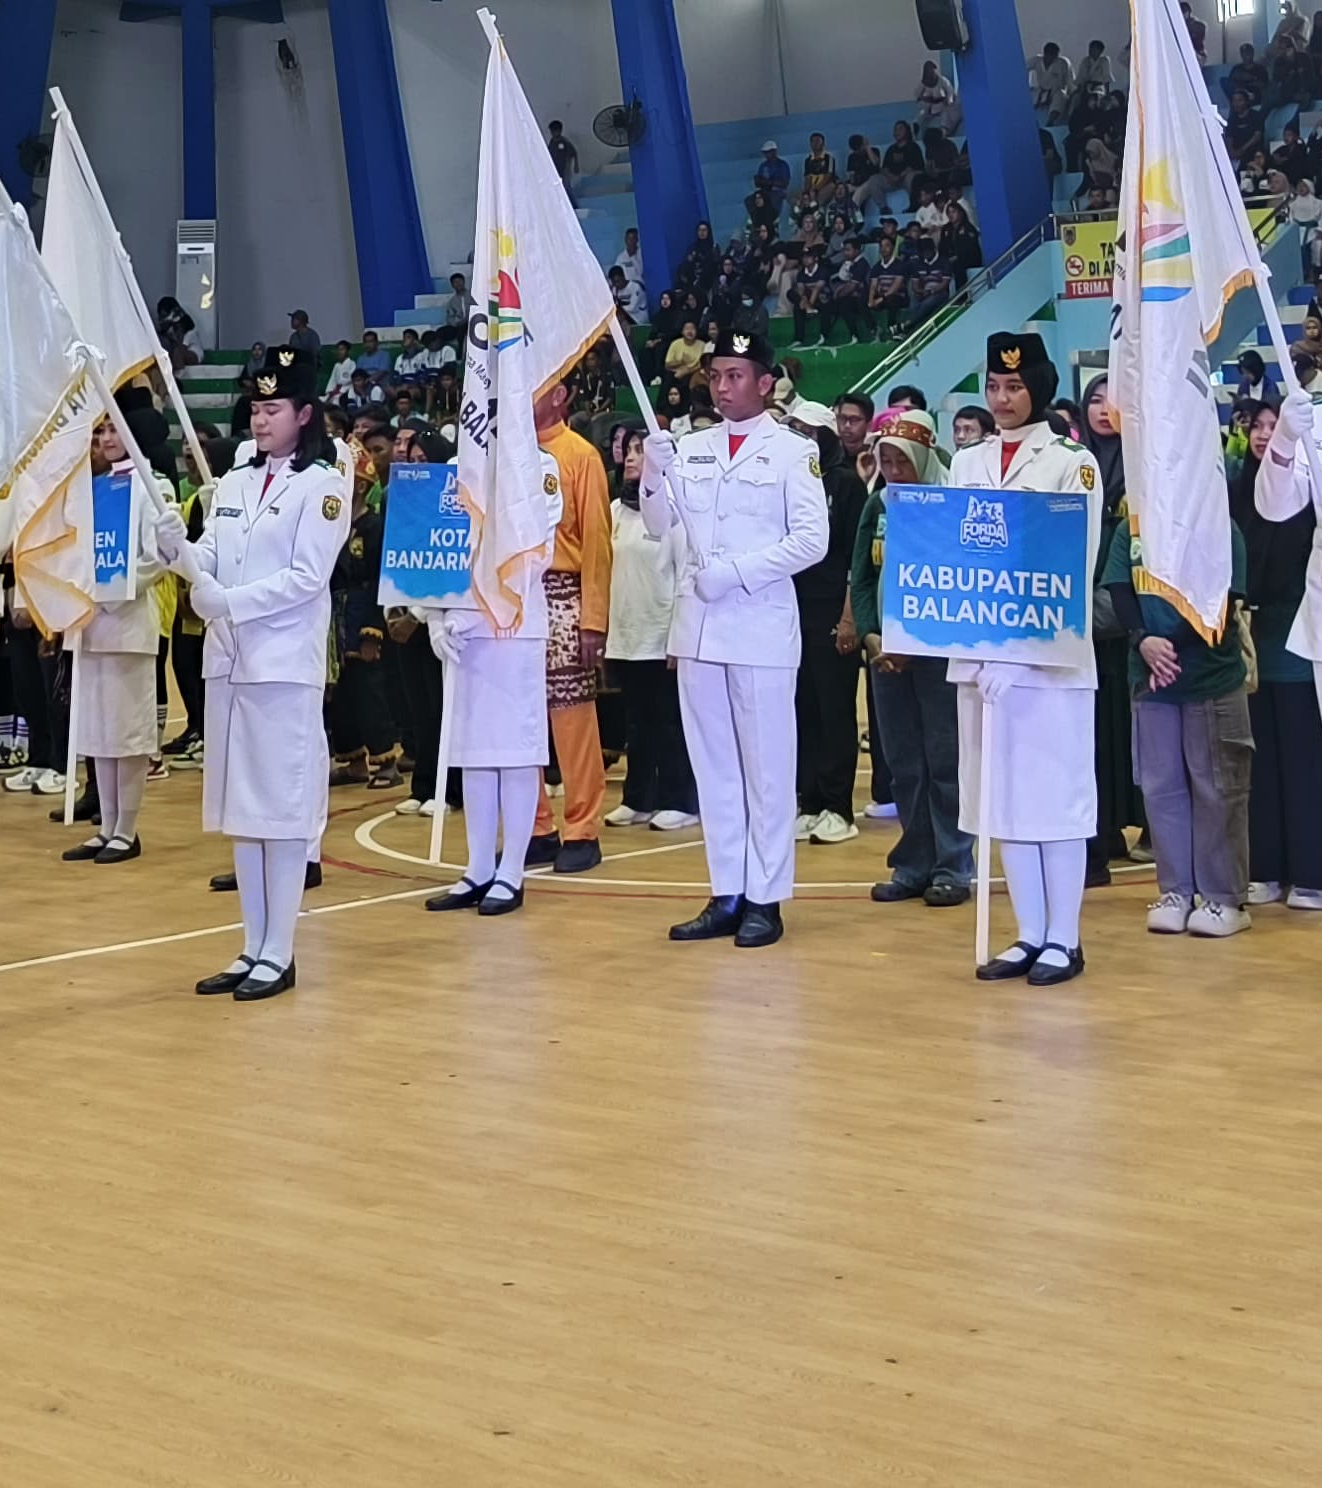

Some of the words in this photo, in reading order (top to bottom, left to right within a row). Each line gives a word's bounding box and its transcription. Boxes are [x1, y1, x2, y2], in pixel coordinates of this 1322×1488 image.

[1088, 262, 1100, 277] DI
[1071, 280, 1109, 296] TERIMA
[962, 522, 1005, 542] FORDA
[898, 563, 1071, 600] KABUPATEN
[902, 594, 1064, 630] BALANGAN
